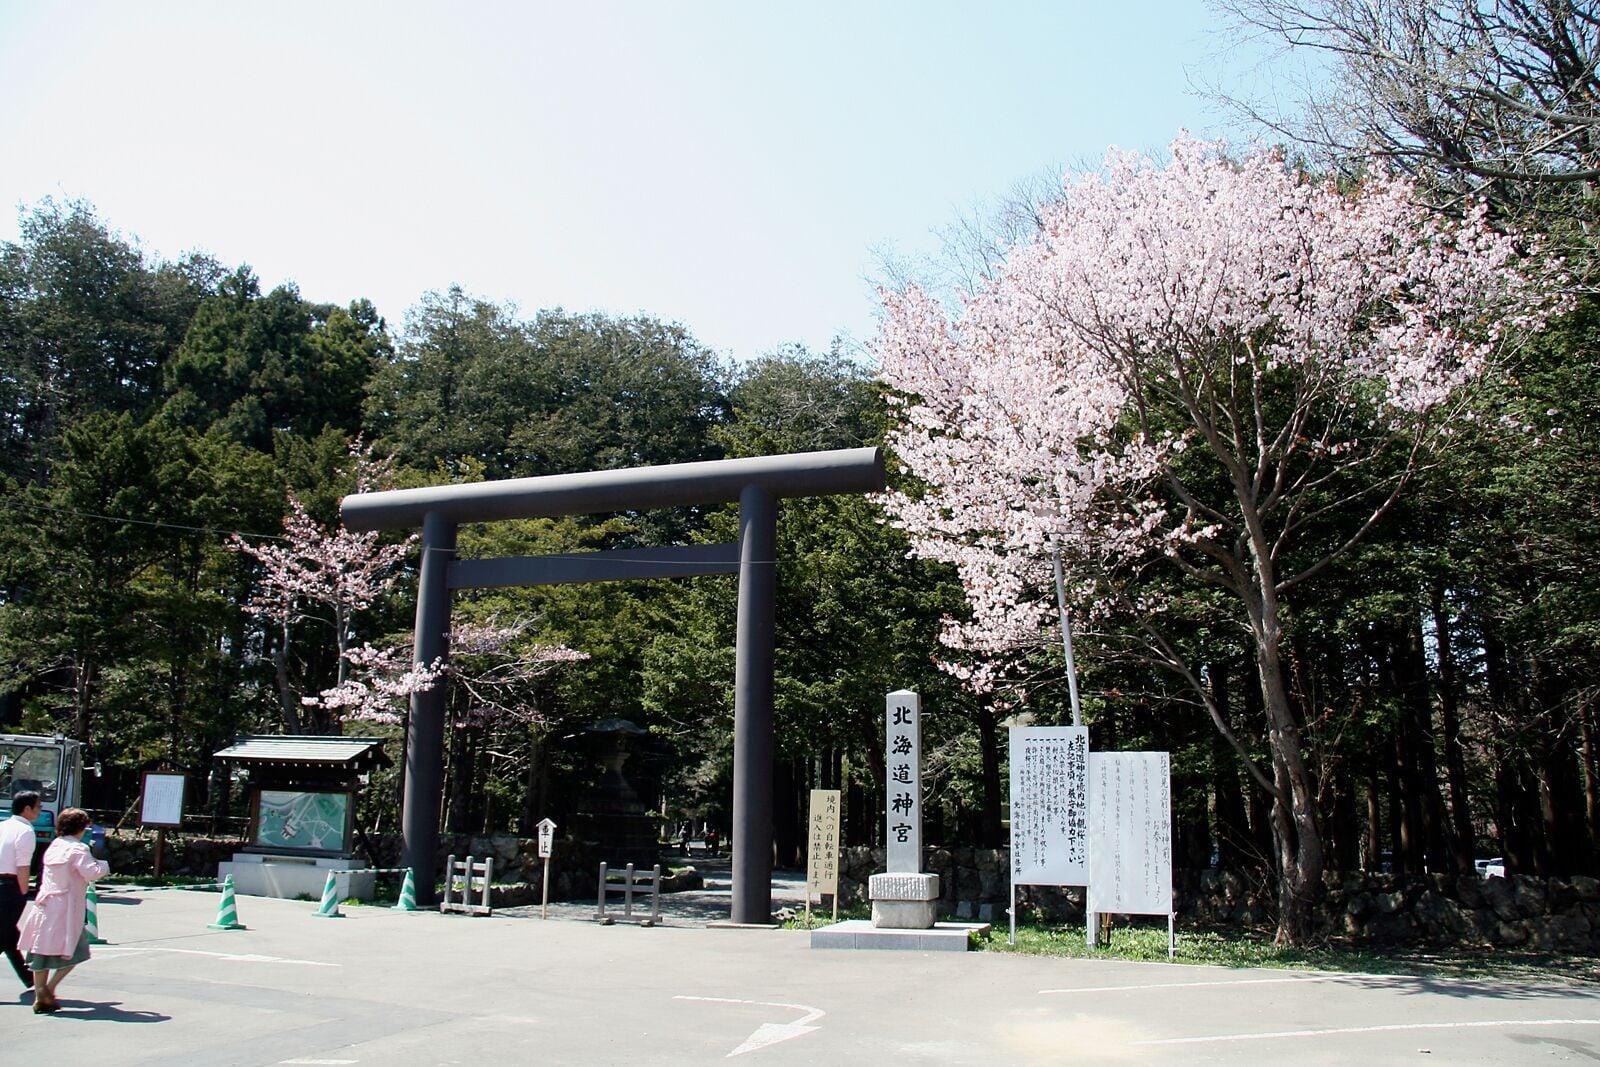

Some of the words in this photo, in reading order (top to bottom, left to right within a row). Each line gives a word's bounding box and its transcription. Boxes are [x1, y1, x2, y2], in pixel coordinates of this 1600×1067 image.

[891, 705, 914, 843] 北海道神宮
[541, 824, 550, 854] 車止
[811, 814, 823, 888] 進入は禁止します
[824, 794, 837, 880] 境内への自転車通行
